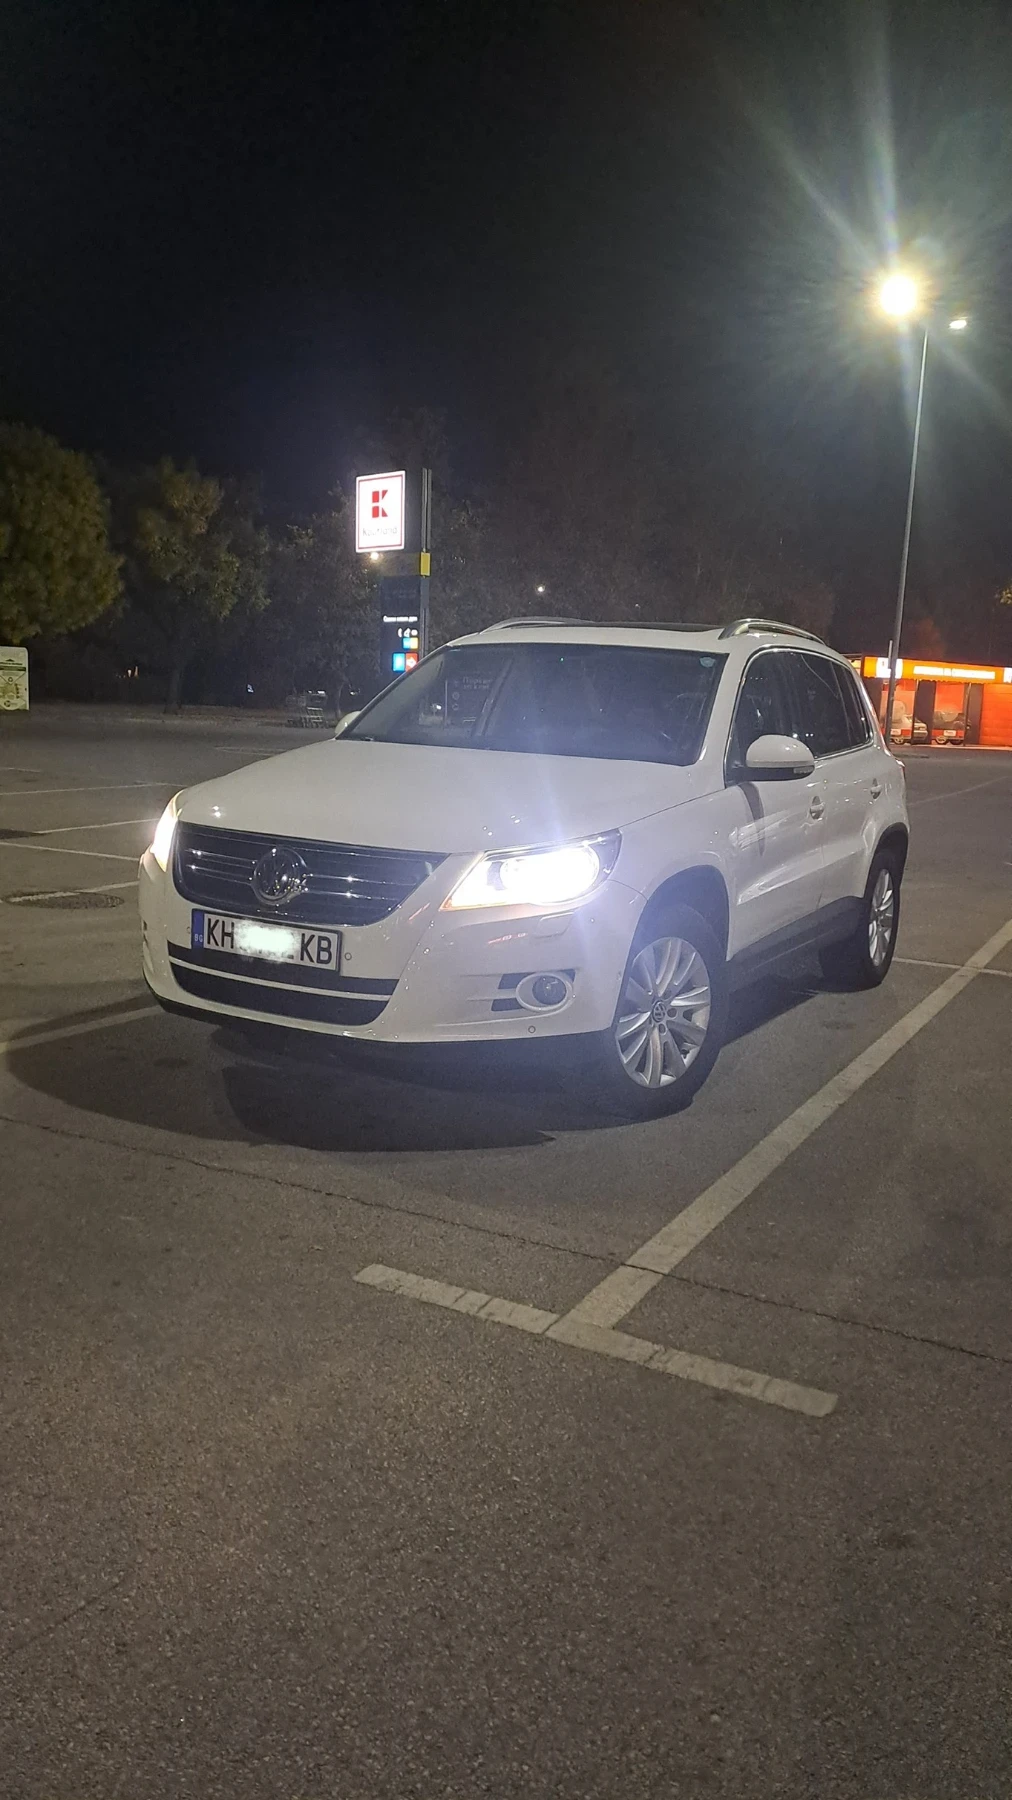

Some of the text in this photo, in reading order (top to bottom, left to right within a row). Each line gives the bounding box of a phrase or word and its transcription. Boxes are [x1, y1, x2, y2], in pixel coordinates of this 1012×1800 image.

[371, 489, 389, 519] K
[206, 917, 235, 949] KH
[299, 932, 333, 965] KB
